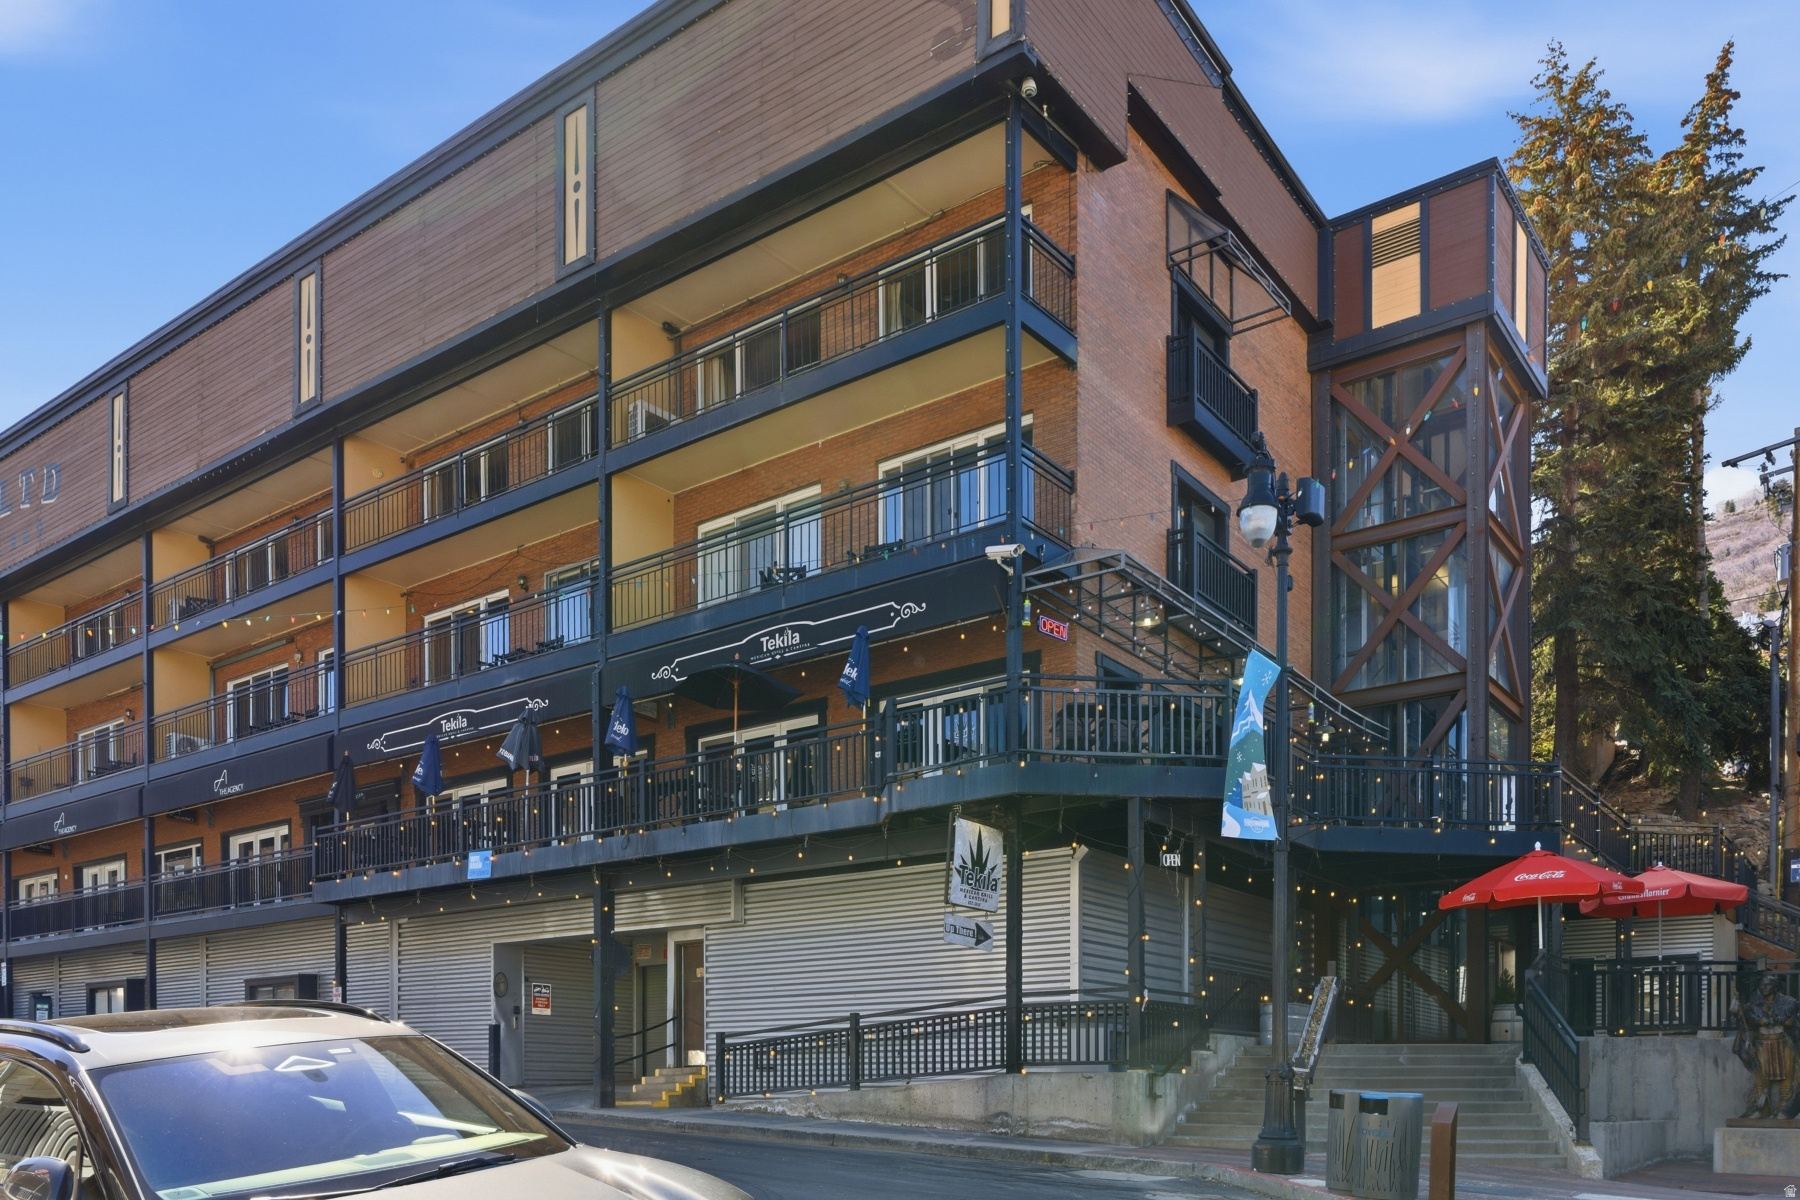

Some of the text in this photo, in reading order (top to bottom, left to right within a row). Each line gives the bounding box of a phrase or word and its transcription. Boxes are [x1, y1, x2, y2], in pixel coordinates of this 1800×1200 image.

[1042, 619, 1067, 639] OPEN
[760, 630, 801, 652] Tekila
[440, 715, 468, 733] Tekila
[1163, 853, 1181, 867] OPEN
[960, 865, 998, 892] Tekila
